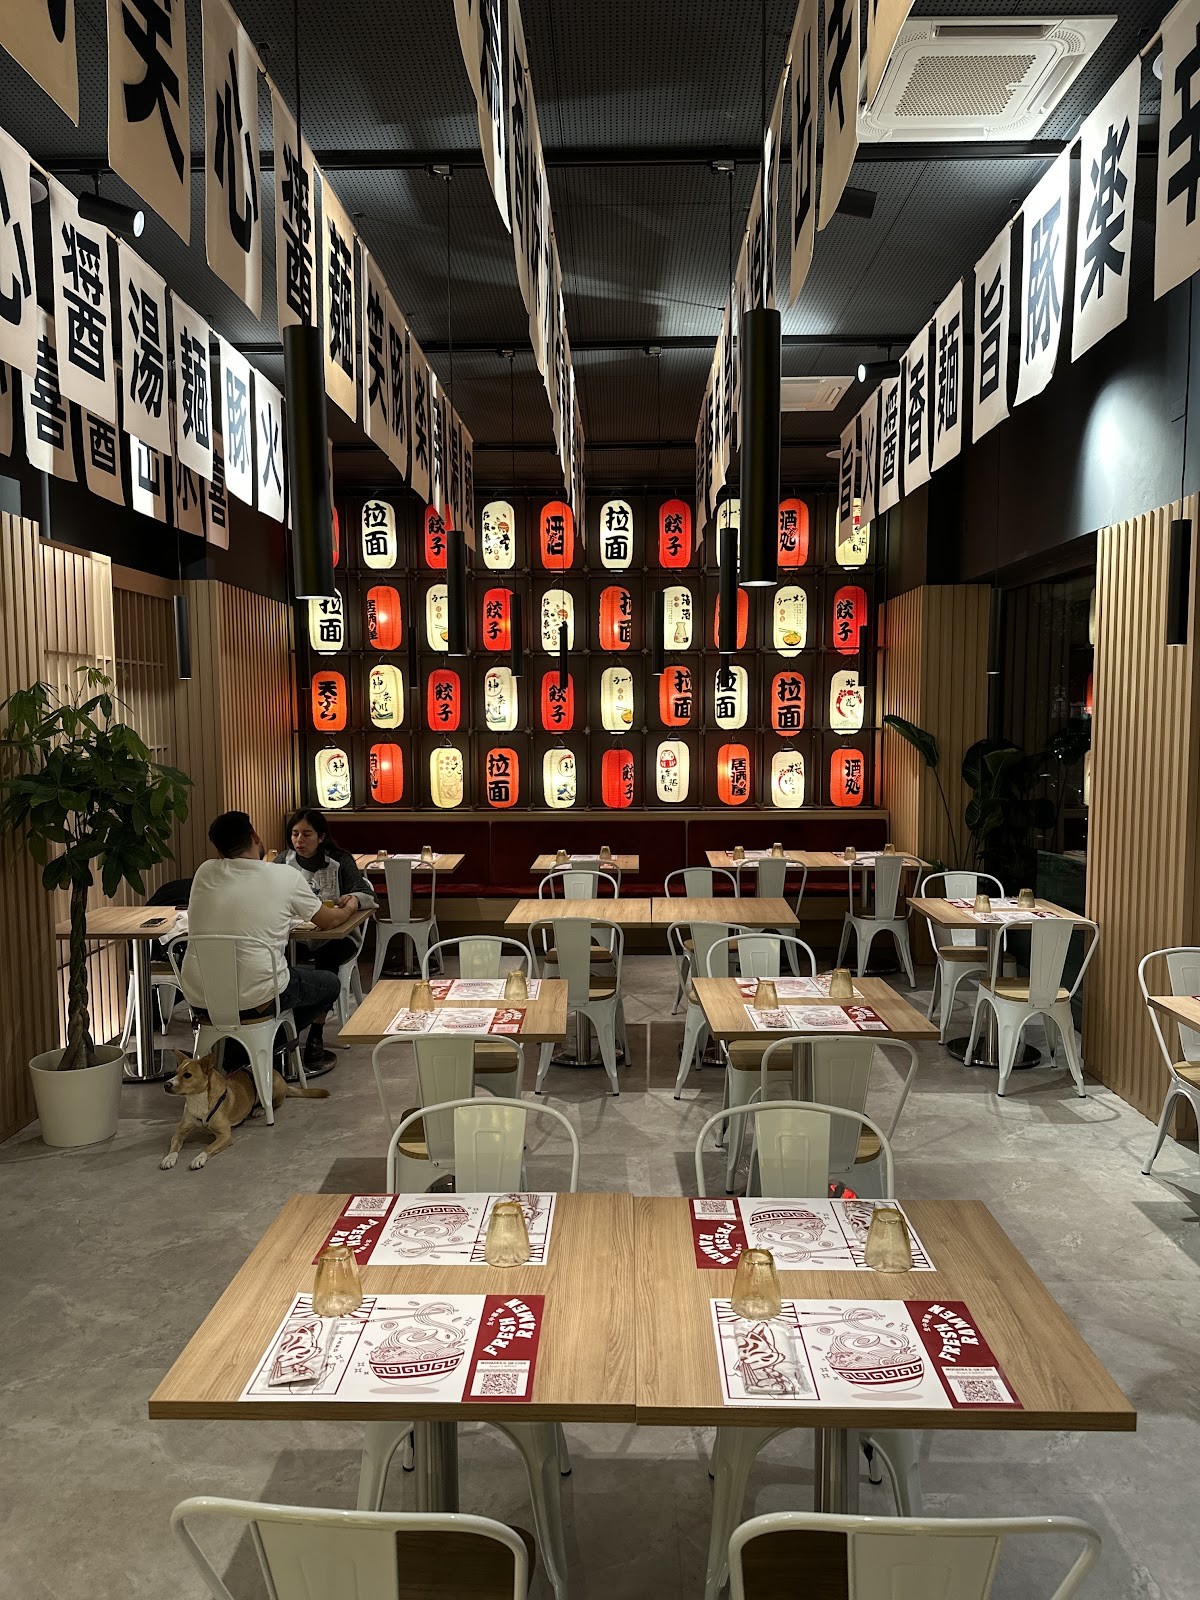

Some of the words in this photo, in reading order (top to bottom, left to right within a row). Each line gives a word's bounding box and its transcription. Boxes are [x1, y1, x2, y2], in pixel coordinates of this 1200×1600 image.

[1081, 115, 1131, 313] 楽
[1026, 197, 1061, 365] 豚
[128, 278, 164, 418] 湯
[226, 367, 249, 474] 豚
[907, 354, 925, 464] 香
[261, 402, 282, 495] 火
[364, 503, 388, 556] 拉面
[429, 516, 446, 556] 餃子
[605, 506, 630, 560] 拉面
[665, 514, 683, 557] 餃子
[486, 601, 503, 640] 餃子
[836, 600, 853, 642] 餃子
[318, 681, 337, 721] 天ぷら
[435, 683, 453, 722] 餃子
[549, 684, 567, 723] 餃子
[777, 677, 802, 728] 拉面
[488, 754, 510, 802] 拉面
[346, 1219, 380, 1248] FRESH
[698, 1233, 734, 1265] RAMEN
[714, 1222, 736, 1250] FRESH
[482, 1317, 517, 1357] FRESH
[504, 1298, 536, 1339] RAMEN
[927, 1304, 980, 1346] RAMEN
[933, 1323, 962, 1363] FRESH
